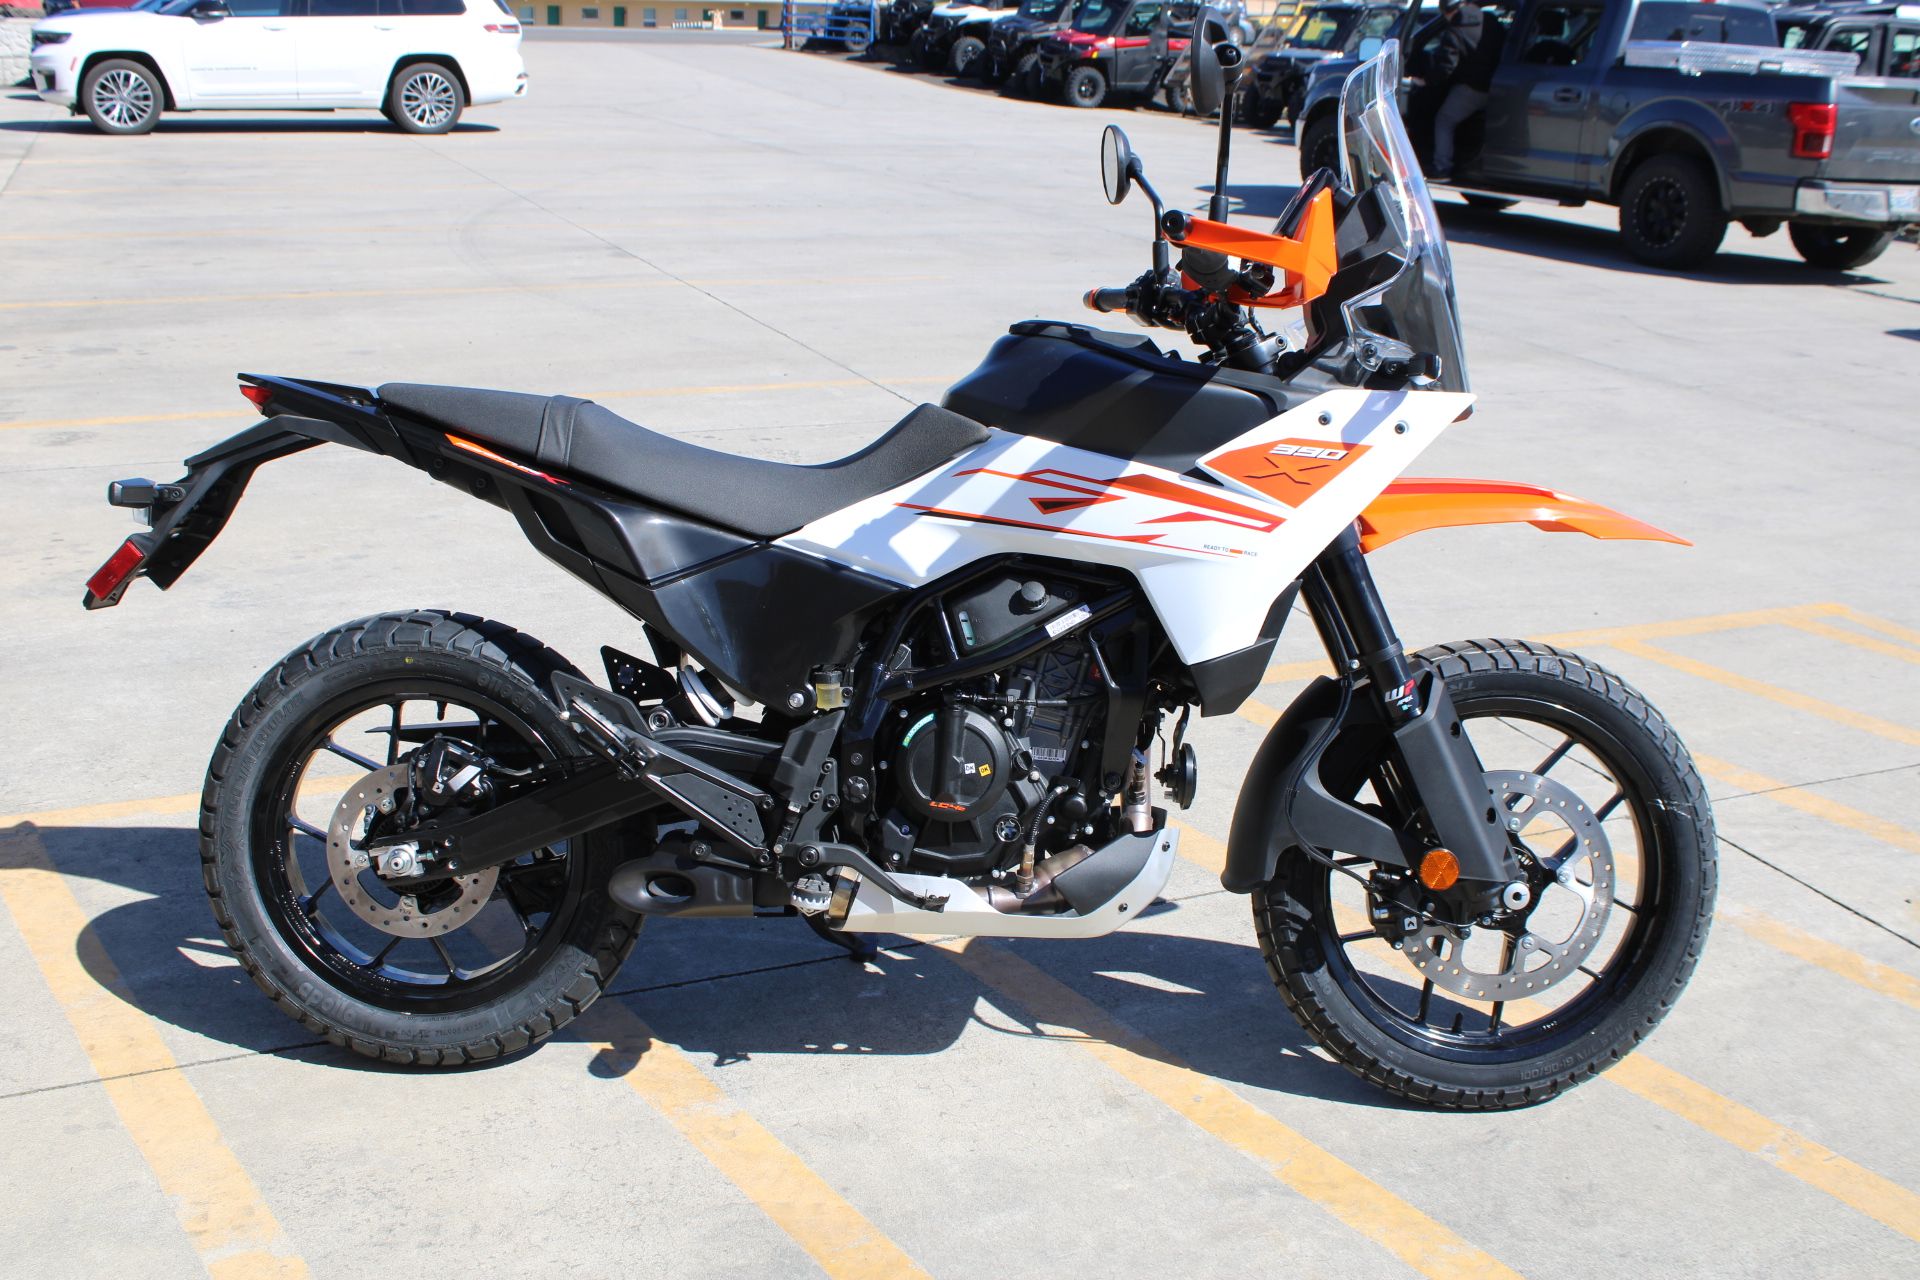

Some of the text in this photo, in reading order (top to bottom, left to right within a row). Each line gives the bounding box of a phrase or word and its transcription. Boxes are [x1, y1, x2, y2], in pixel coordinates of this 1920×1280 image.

[1268, 444, 1349, 461] 390
[1384, 679, 1415, 702] WP
[980, 765, 989, 774] OK
[299, 981, 354, 1022] apollo
[1519, 1056, 1575, 1081] 100/90-19
